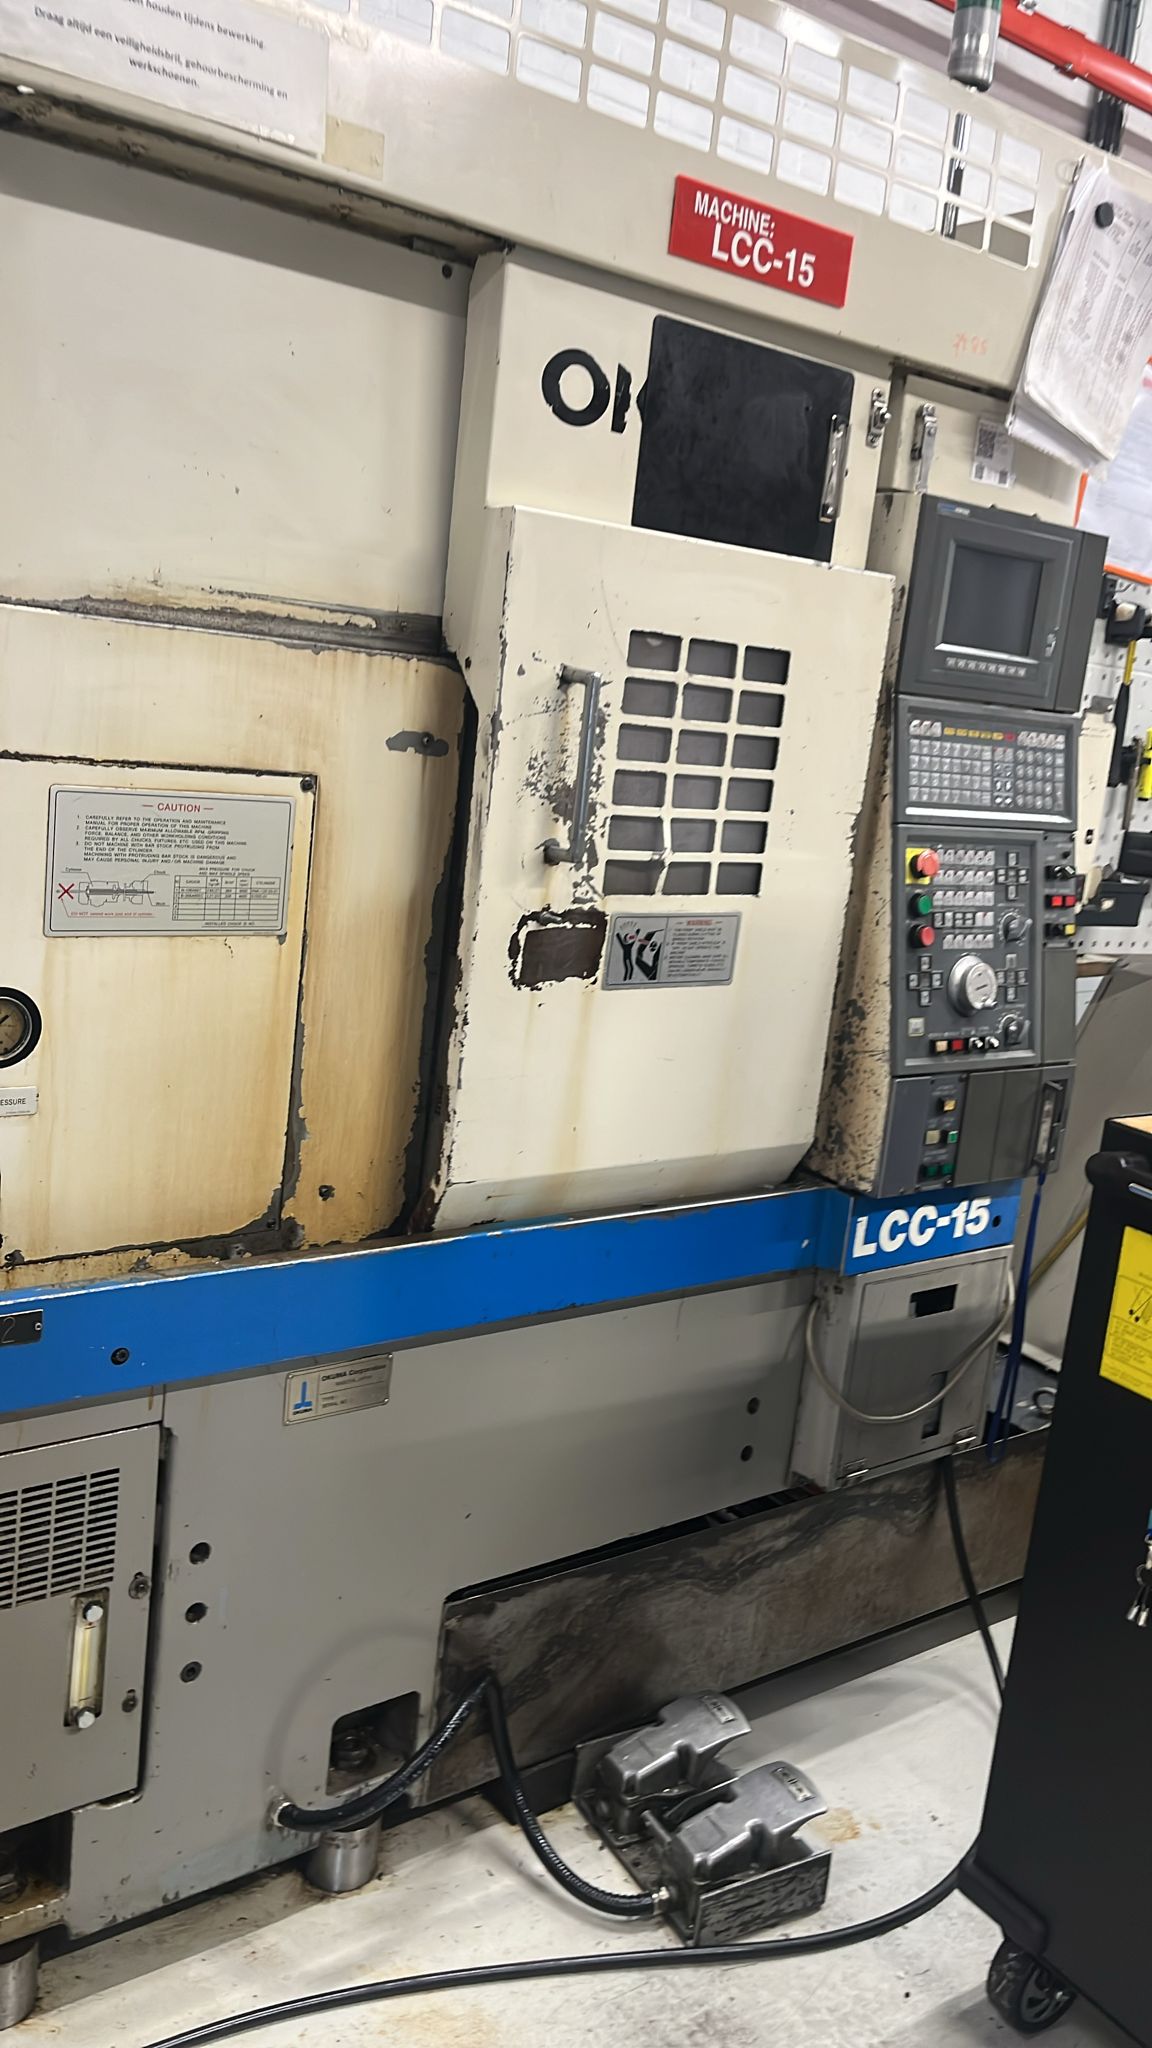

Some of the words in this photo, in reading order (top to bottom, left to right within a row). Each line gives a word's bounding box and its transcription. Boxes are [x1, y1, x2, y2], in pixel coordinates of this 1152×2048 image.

[145, 0, 182, 18] houden
[184, 13, 214, 31] tijdens
[34, 5, 65, 27] Draag
[66, 18, 92, 36] altijd
[94, 28, 113, 41] een
[184, 59, 275, 97] gehoorbescherming
[276, 90, 288, 100] en
[129, 57, 201, 88] werkschoenen.
[694, 190, 776, 239] MACHINE:
[711, 222, 816, 288] LCC-15
[157, 802, 201, 813] CAUTION
[0, 1098, 27, 1106] ESSURE
[852, 1197, 992, 1258] LCC-15
